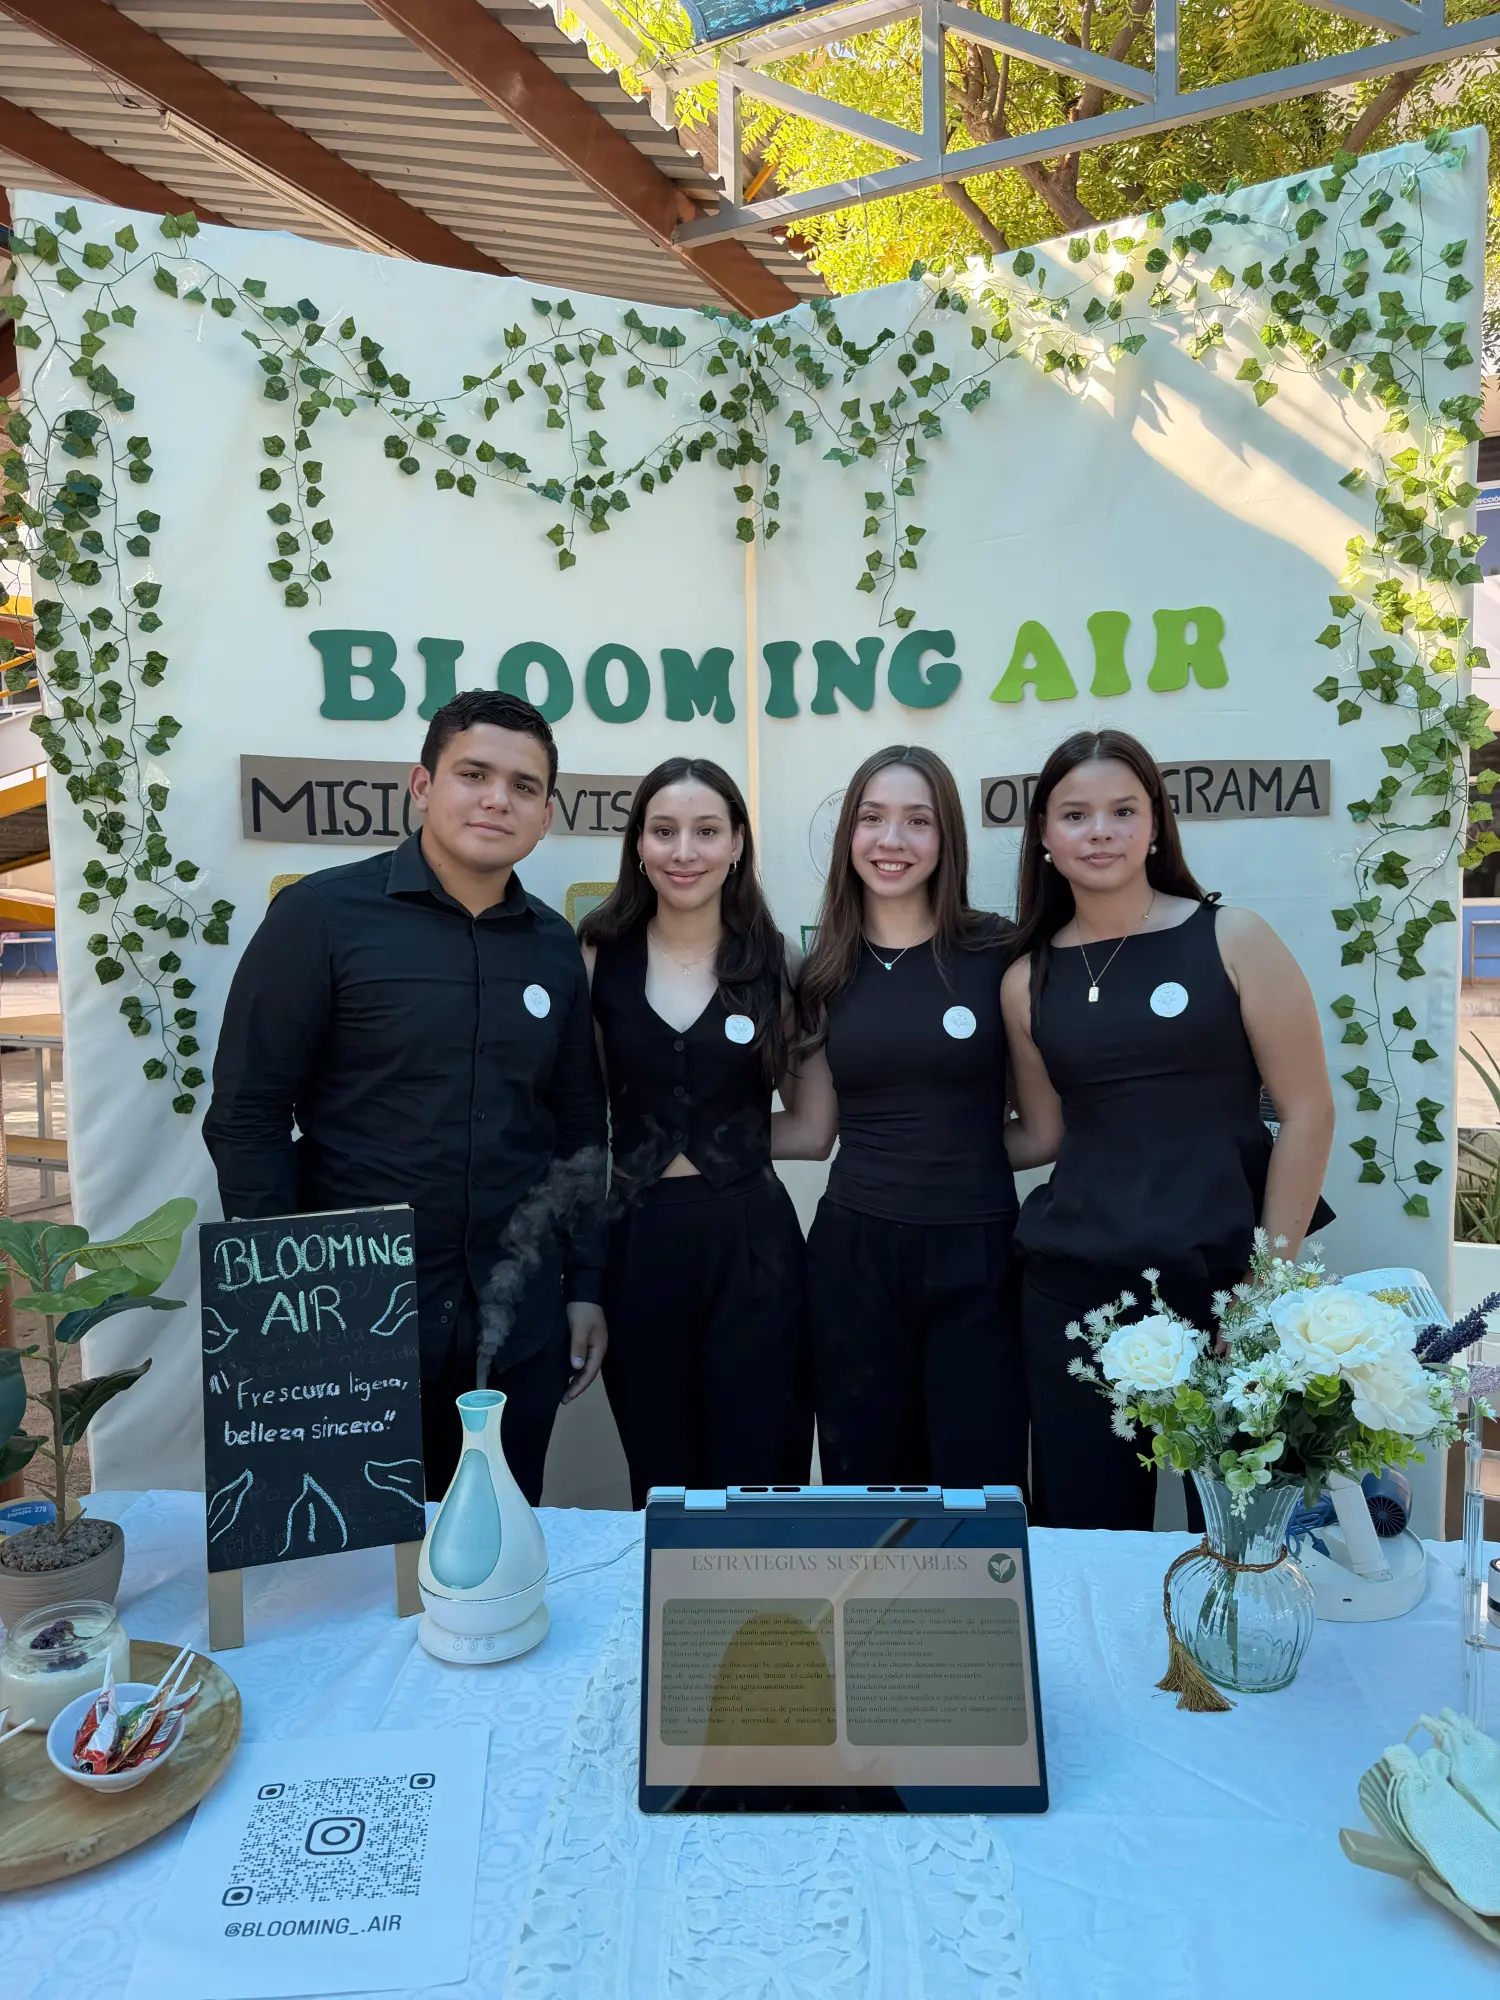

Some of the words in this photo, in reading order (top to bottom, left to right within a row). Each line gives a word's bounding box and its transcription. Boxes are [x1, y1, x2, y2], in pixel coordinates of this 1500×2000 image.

[308, 629, 962, 723] BLOOMING
[989, 606, 1230, 703] AIR
[251, 777, 413, 837] MISI
[552, 788, 632, 832] VIS
[213, 1233, 414, 1292] BLOOMING
[260, 1284, 347, 1336] AIR
[224, 1420, 305, 1446] belleza
[692, 1554, 818, 1571] ESTRATEGIAS
[827, 1554, 968, 1571] SUSTENTABLES
[224, 1914, 402, 1938] @BLOOMING_.AIR
